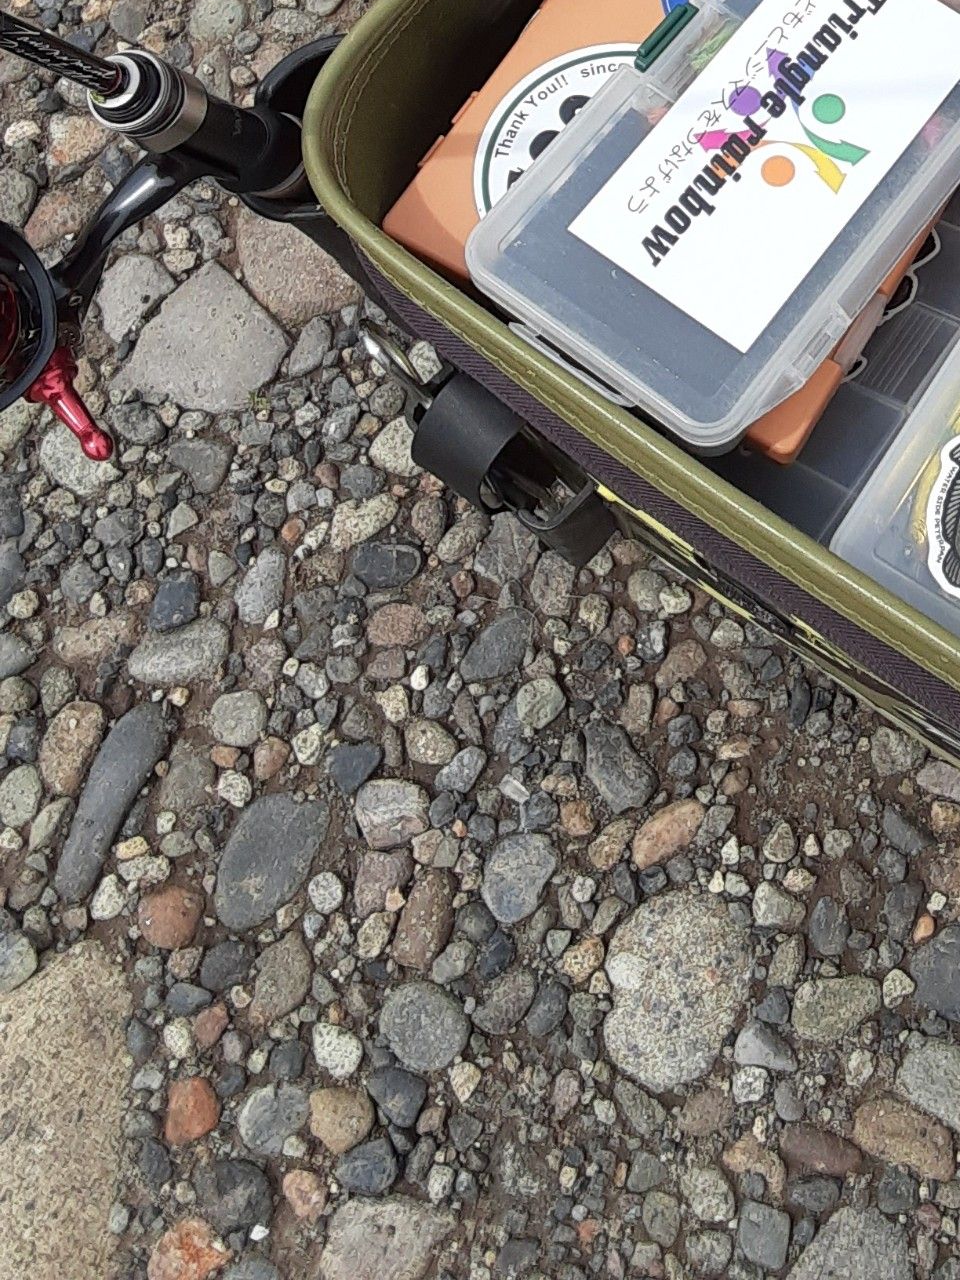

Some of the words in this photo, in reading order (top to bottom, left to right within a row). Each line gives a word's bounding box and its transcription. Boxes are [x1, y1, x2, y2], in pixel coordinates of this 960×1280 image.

[494, 110, 530, 159] Thank
[524, 74, 569, 108] You!!
[641, 114, 768, 267] rainbow
[934, 494, 943, 515] SIDE
[940, 466, 957, 494] WATER
